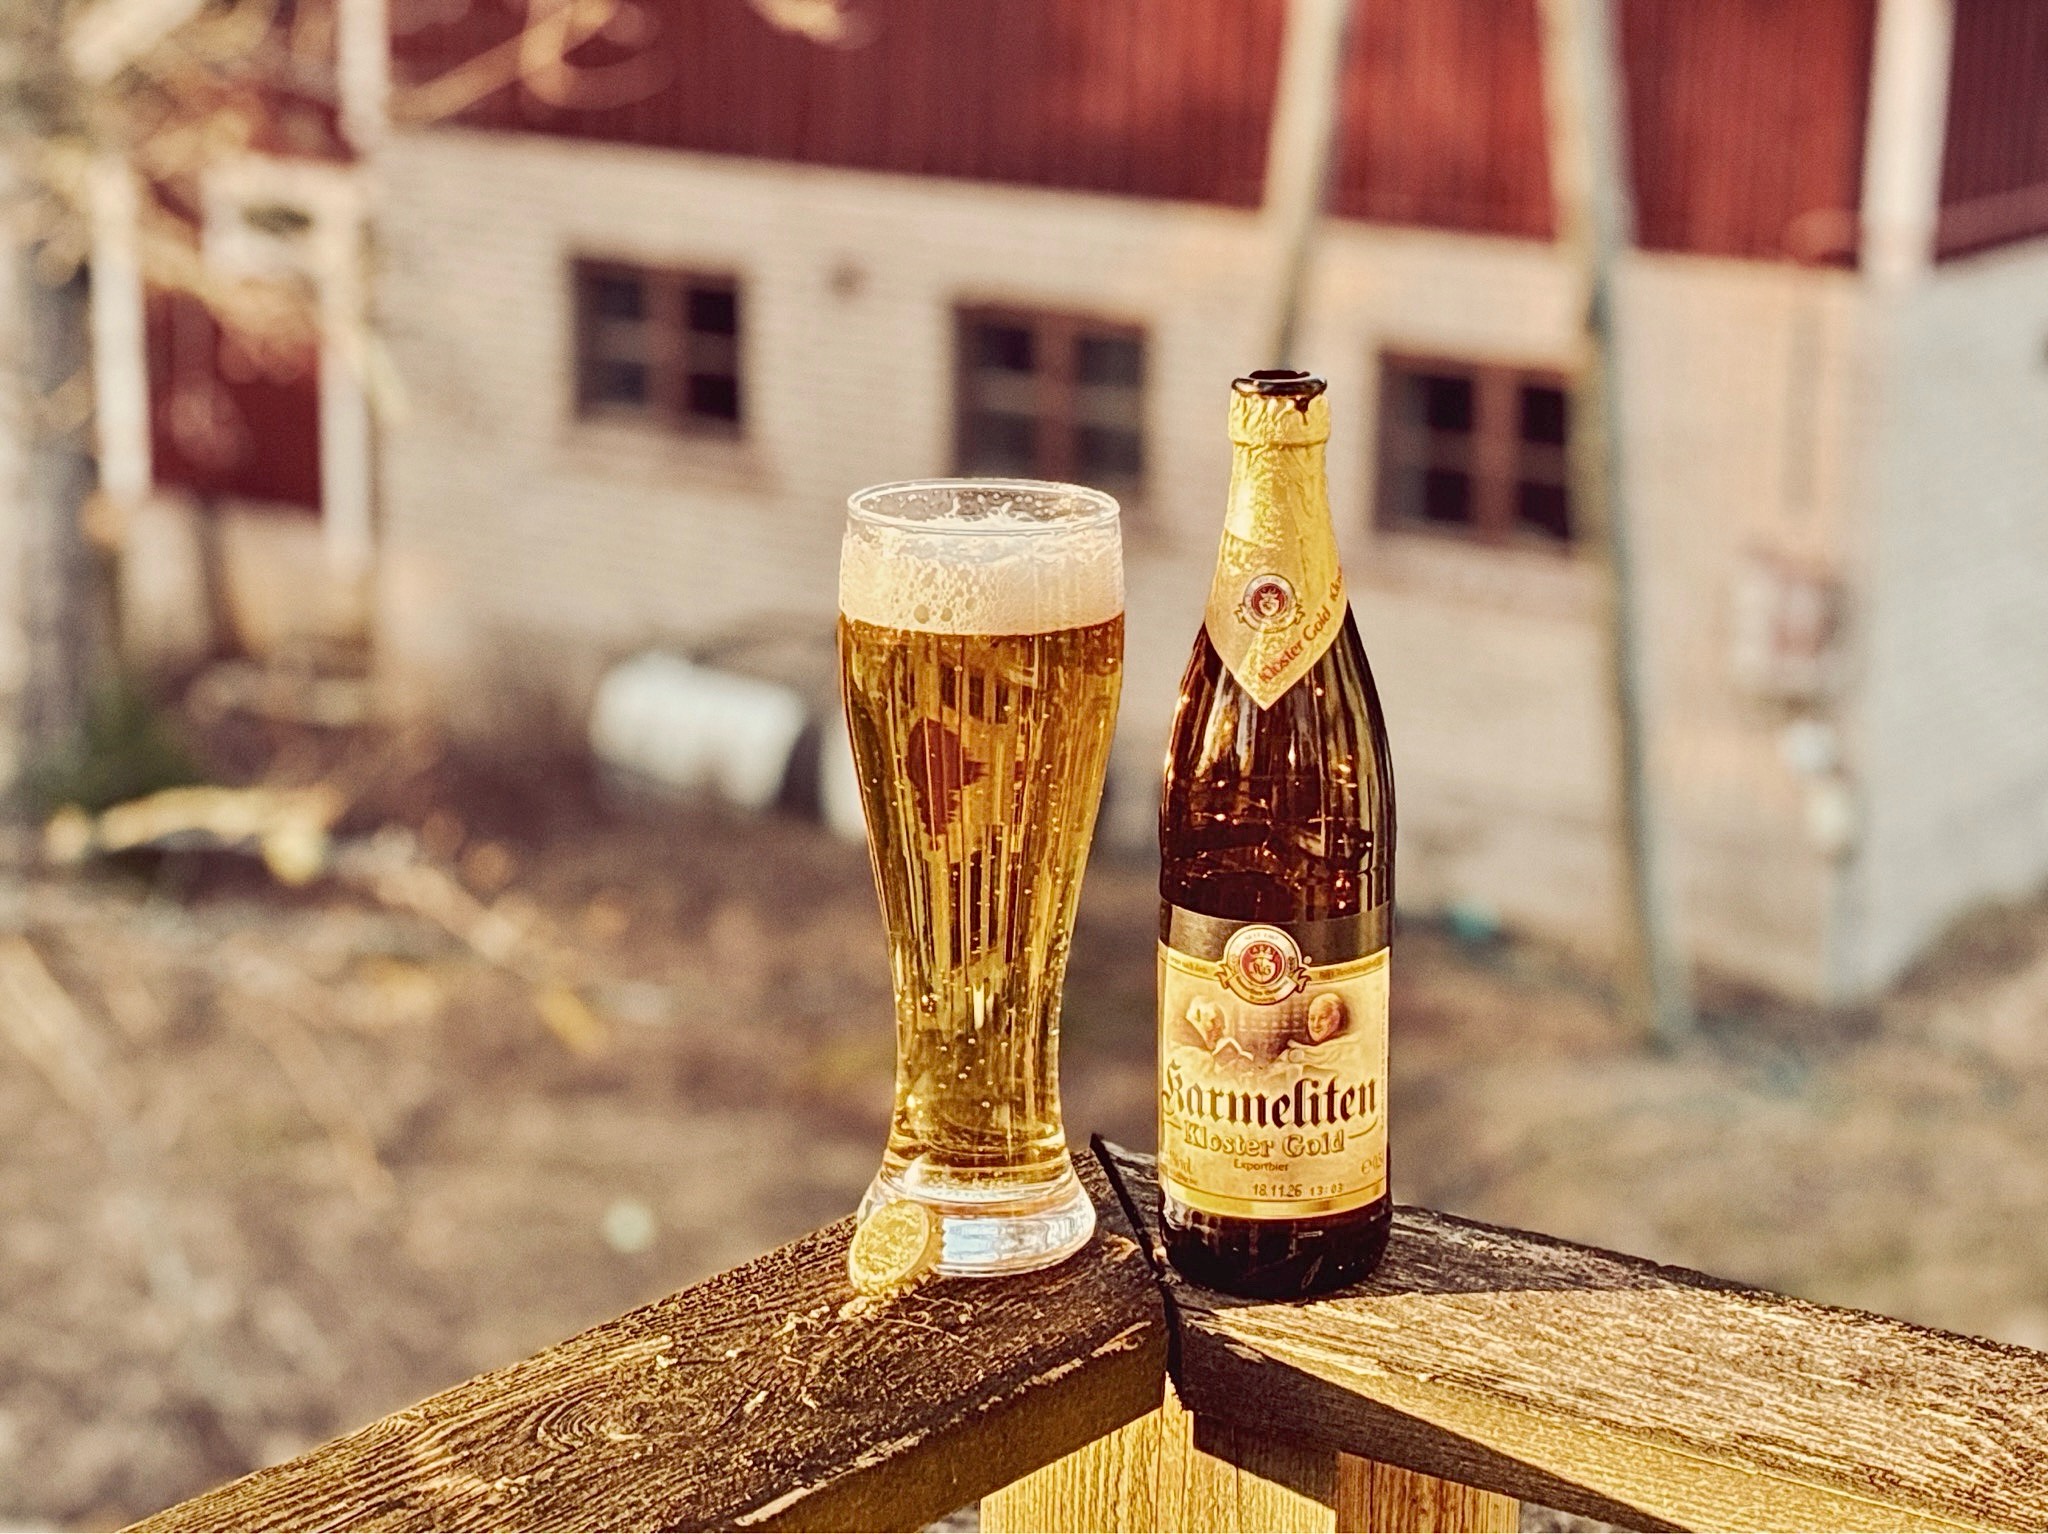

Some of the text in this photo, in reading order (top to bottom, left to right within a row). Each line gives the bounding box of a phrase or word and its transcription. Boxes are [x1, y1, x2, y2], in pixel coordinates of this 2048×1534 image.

[1258, 640, 1304, 683] Kloster
[1303, 605, 1331, 641] Gold
[1162, 1059, 1377, 1129] Karmeliten
[1184, 1120, 1345, 1158] Kloster Gold
[1234, 1158, 1288, 1173] Exportbier
